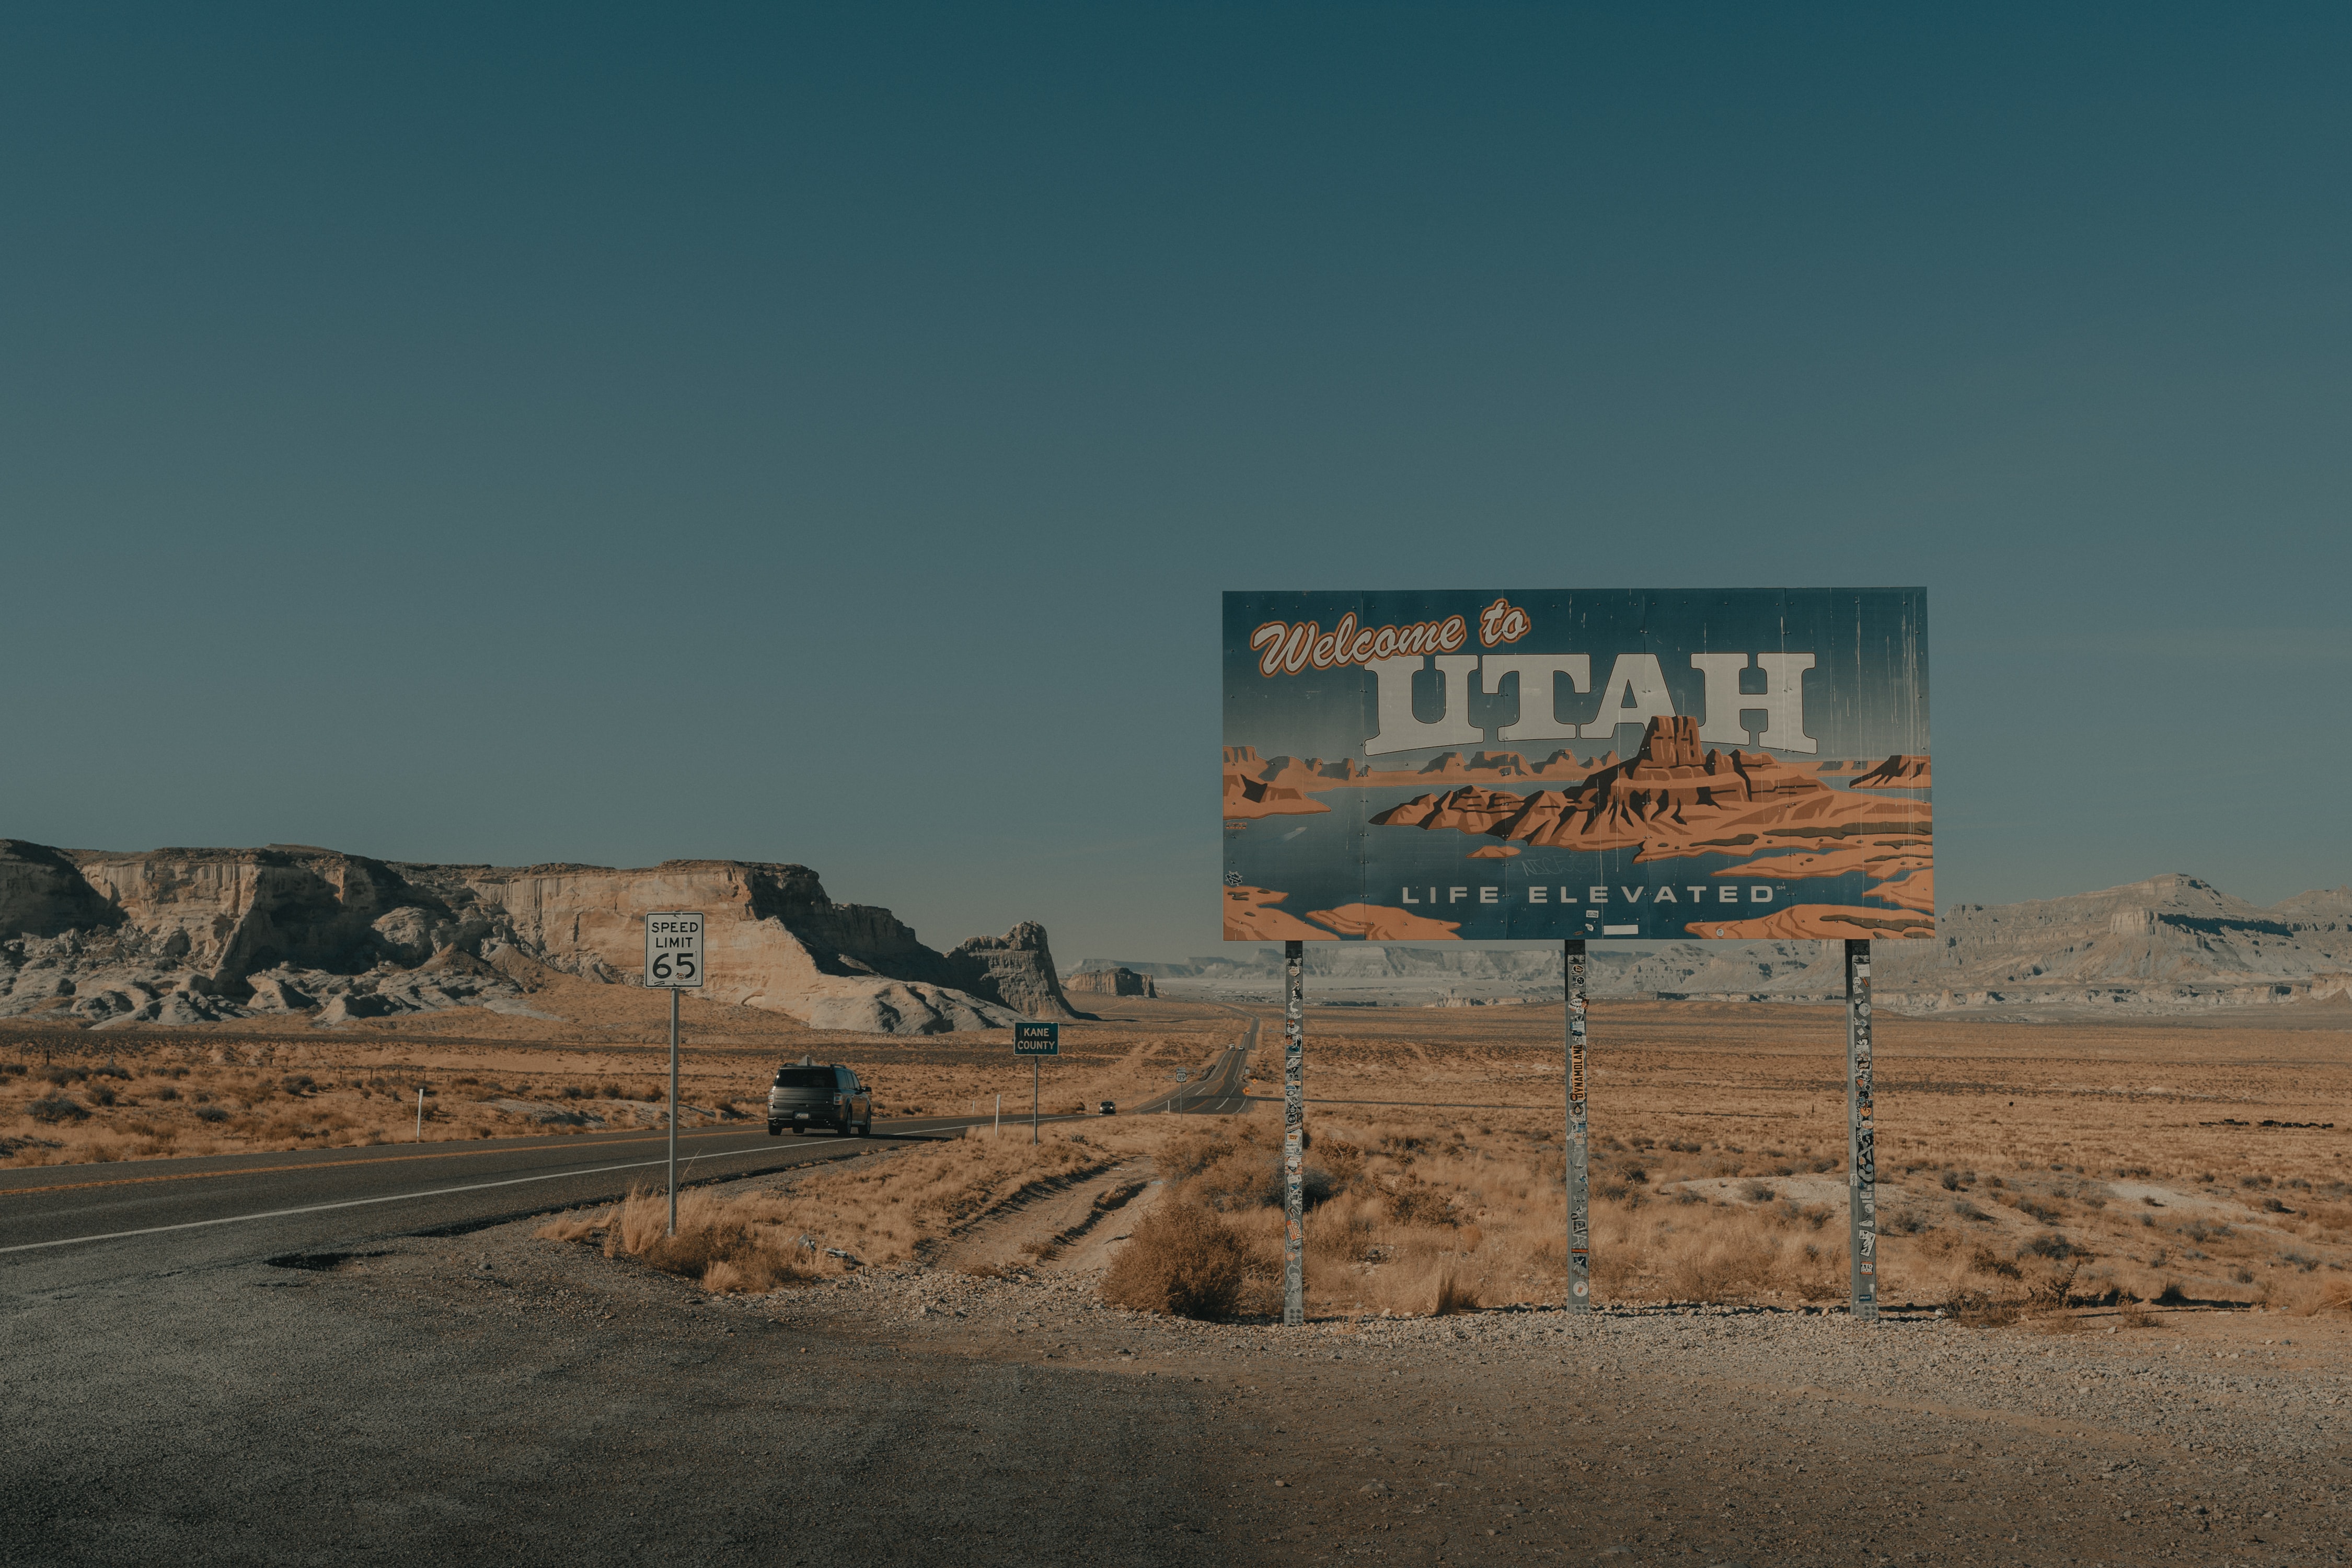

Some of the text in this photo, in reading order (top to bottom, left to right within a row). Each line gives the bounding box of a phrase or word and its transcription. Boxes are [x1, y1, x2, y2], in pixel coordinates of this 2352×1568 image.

[1252, 599, 1530, 676] Welcome to
[1363, 652, 1818, 756] UTAH
[1402, 886, 1499, 904] LIFE
[1529, 885, 1774, 904] ELEVATED
[651, 922, 698, 933] SPEED
[656, 937, 693, 948] LIMIT
[652, 953, 696, 979] 65
[1023, 1028, 1050, 1037] KANE
[1017, 1040, 1055, 1050] COUNTY
